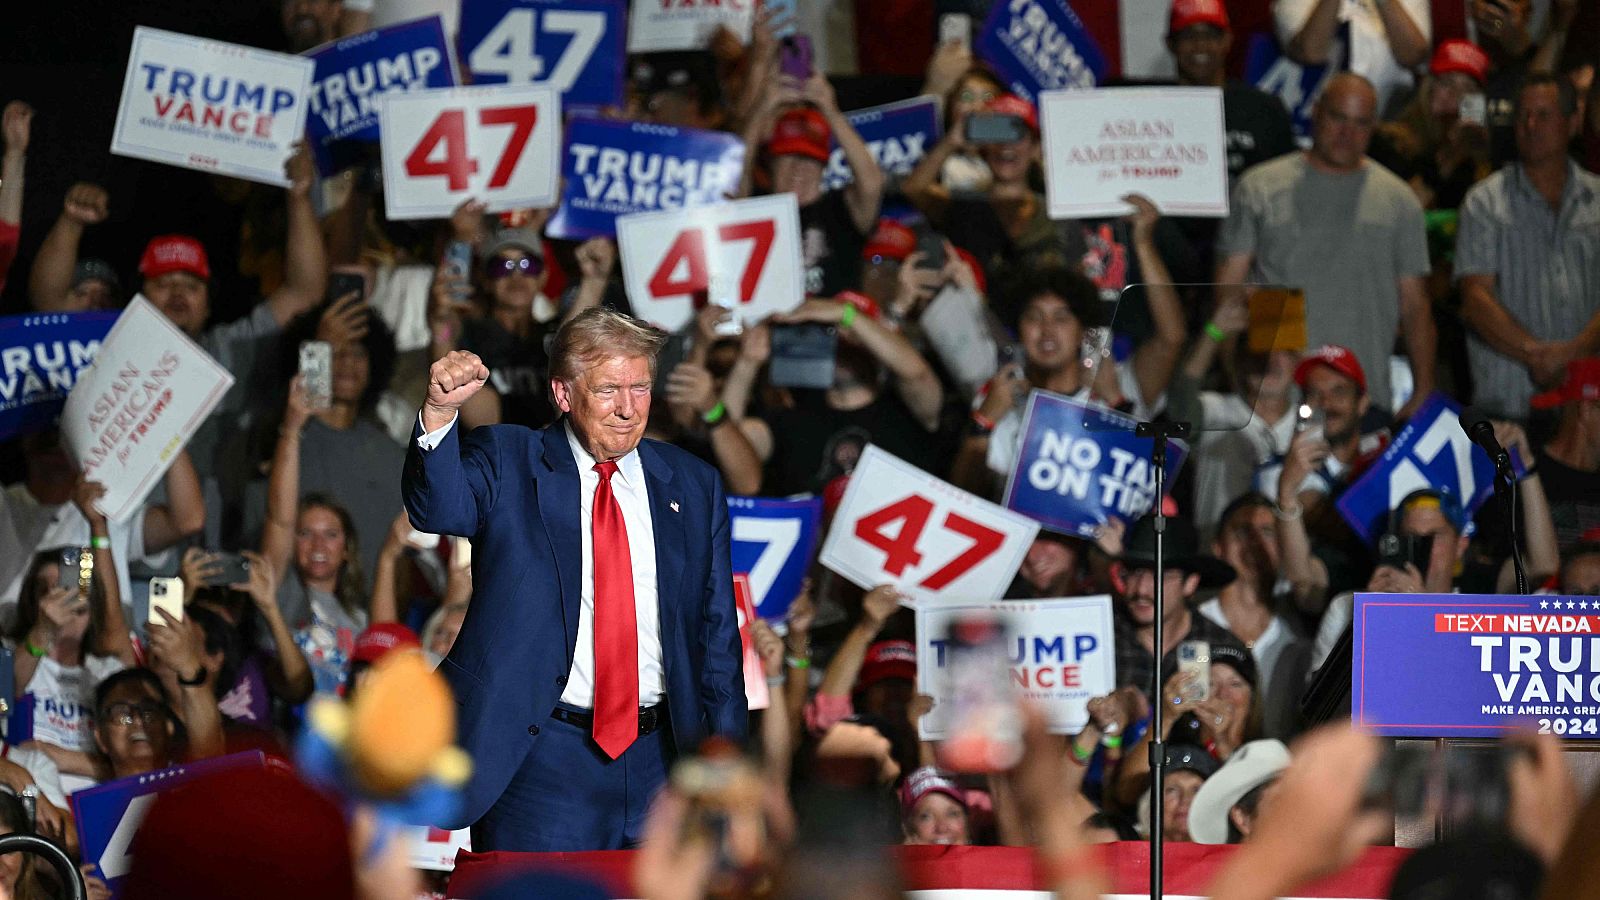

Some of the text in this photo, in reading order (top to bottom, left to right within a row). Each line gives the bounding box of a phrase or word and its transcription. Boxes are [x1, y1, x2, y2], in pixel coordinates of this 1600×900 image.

[468, 7, 607, 94] 47
[141, 62, 296, 117] TRUMP
[153, 94, 275, 139] VANCE
[1099, 119, 1175, 138] ASIAN
[404, 103, 538, 192] 47
[569, 143, 731, 191] TRUMP
[1066, 143, 1209, 165] AMERICANS
[1121, 166, 1183, 179] TRUMP
[648, 218, 777, 304] 47
[88, 360, 141, 433] ASIAN
[127, 388, 174, 444] TRUMP
[1038, 428, 1101, 471] NO
[1028, 459, 1091, 500] ON
[732, 516, 802, 608] 7
[855, 494, 1007, 591] 47
[1444, 614, 1592, 633] TEXT NEVADA
[929, 635, 1098, 669] TUMP
[1481, 705, 1514, 715] MAKE
[1517, 705, 1570, 715] AMERICA
[1537, 718, 1598, 735] 2024
